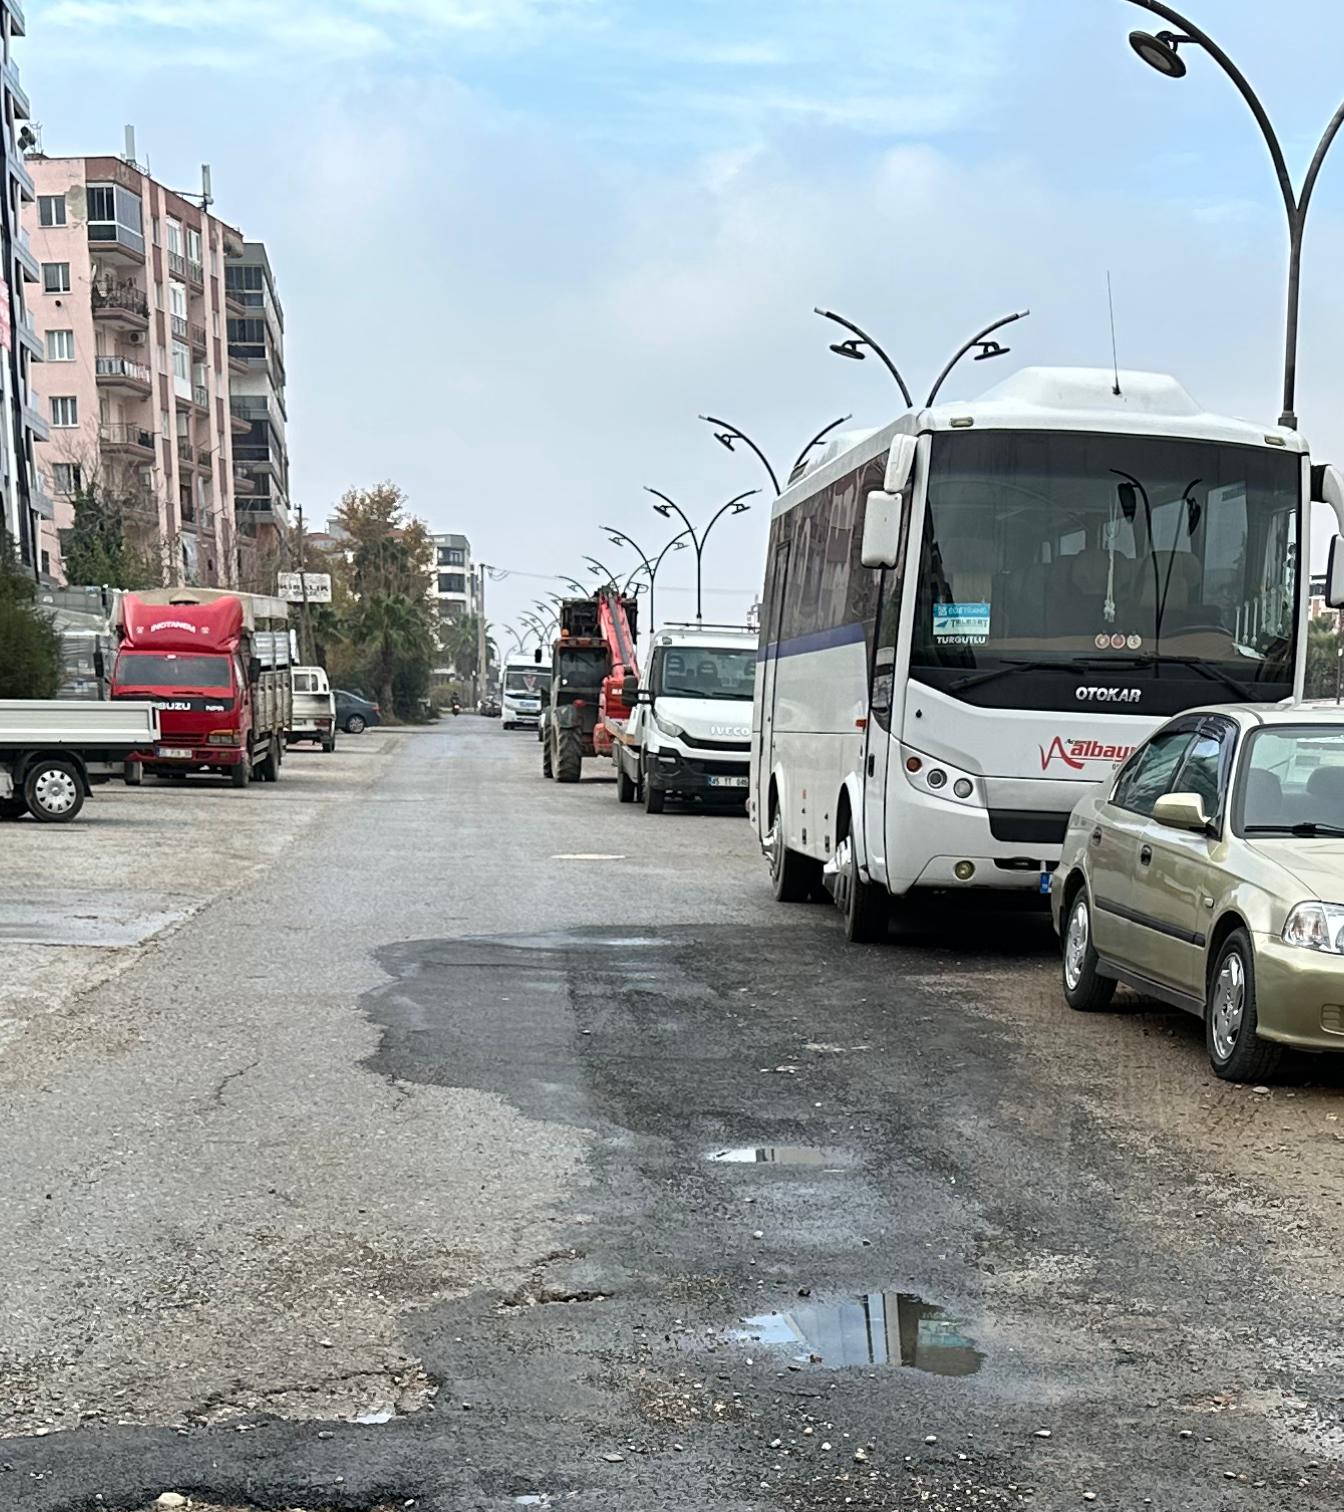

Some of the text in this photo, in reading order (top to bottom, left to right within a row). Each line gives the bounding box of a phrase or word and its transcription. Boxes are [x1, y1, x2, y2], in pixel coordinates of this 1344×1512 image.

[936, 635, 986, 645] TURGUTLU
[1075, 685, 1142, 703] OTOKAR
[710, 725, 750, 737] IVECO
